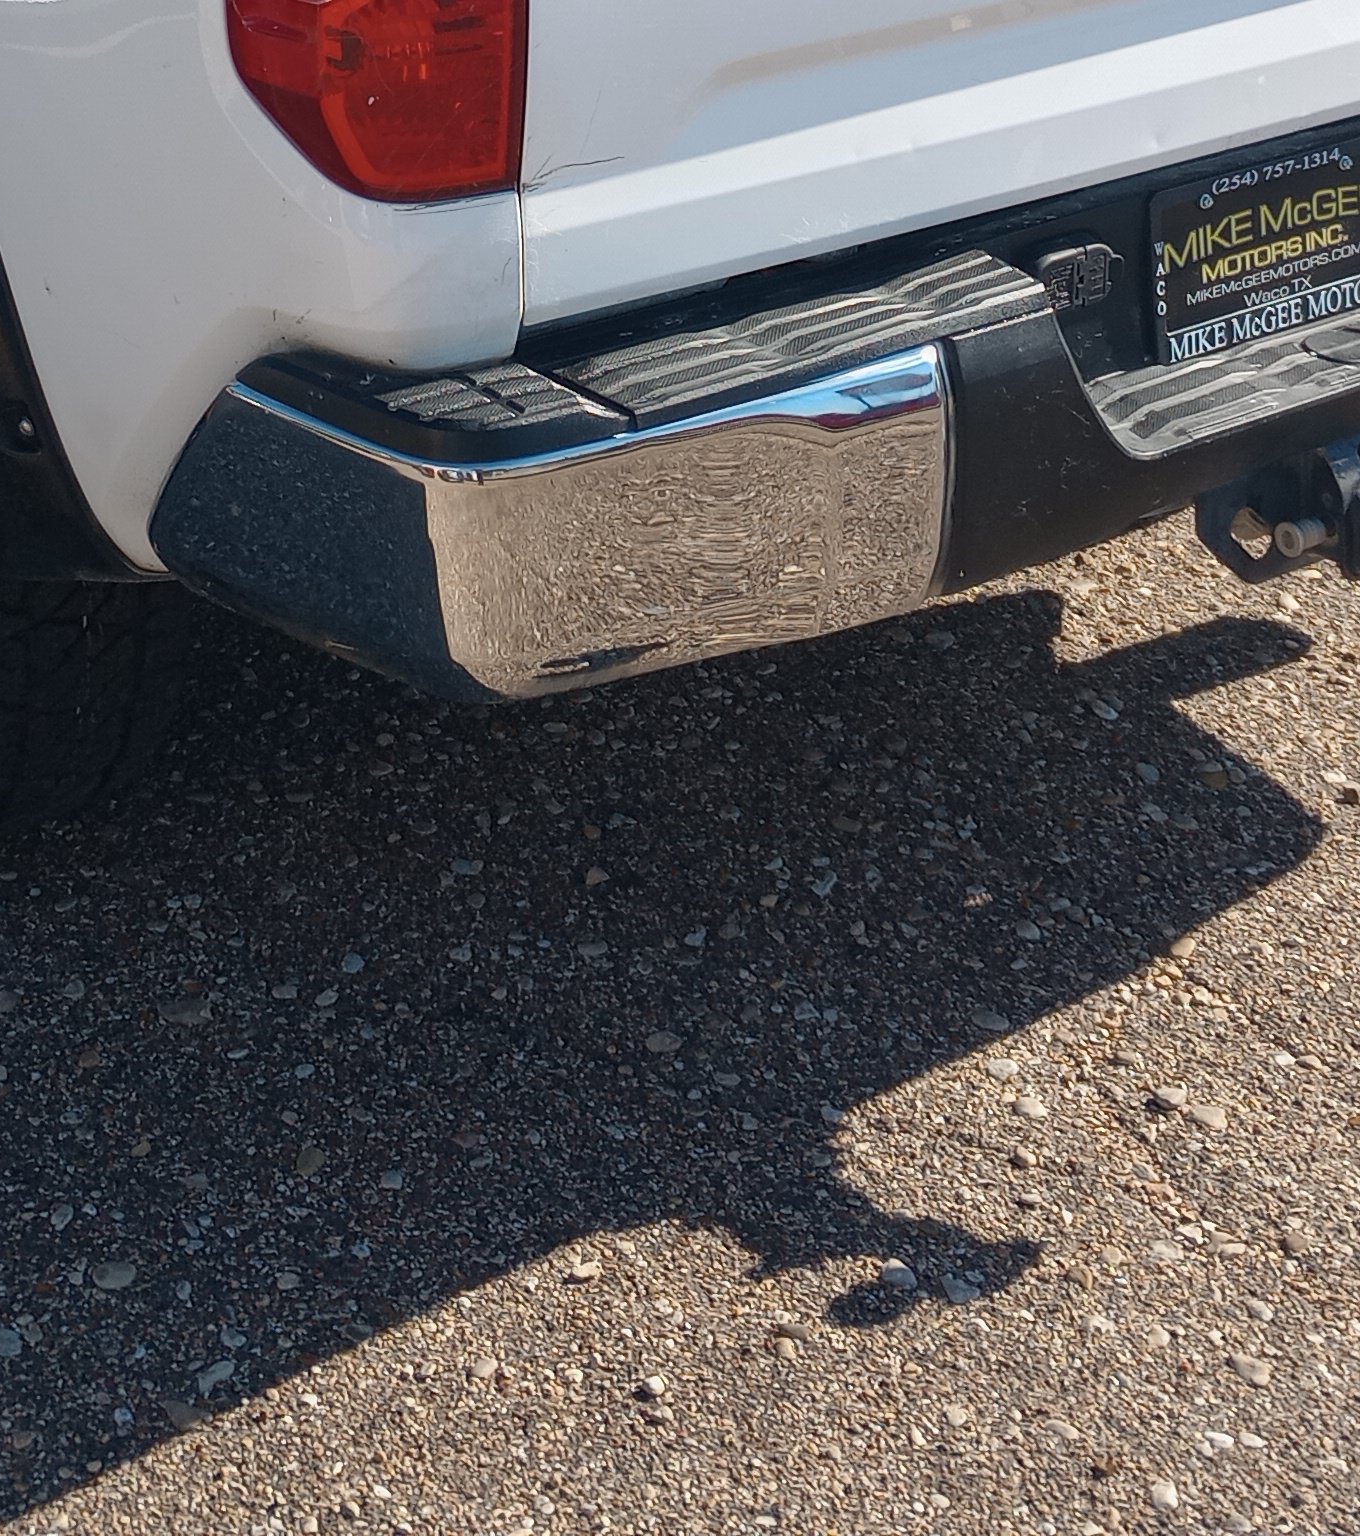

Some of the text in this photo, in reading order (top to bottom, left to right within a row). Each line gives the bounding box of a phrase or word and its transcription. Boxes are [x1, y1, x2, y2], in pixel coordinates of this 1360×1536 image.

[1212, 148, 1340, 196] (254) 757-1314
[1163, 208, 1254, 273] MIKE
[1202, 223, 1349, 284] MOTORS INC.
[1154, 241, 1167, 316] WACO
[1243, 275, 1313, 308] Waco TX
[1169, 322, 1229, 364] MIKE
[1231, 297, 1304, 344] McGEE
